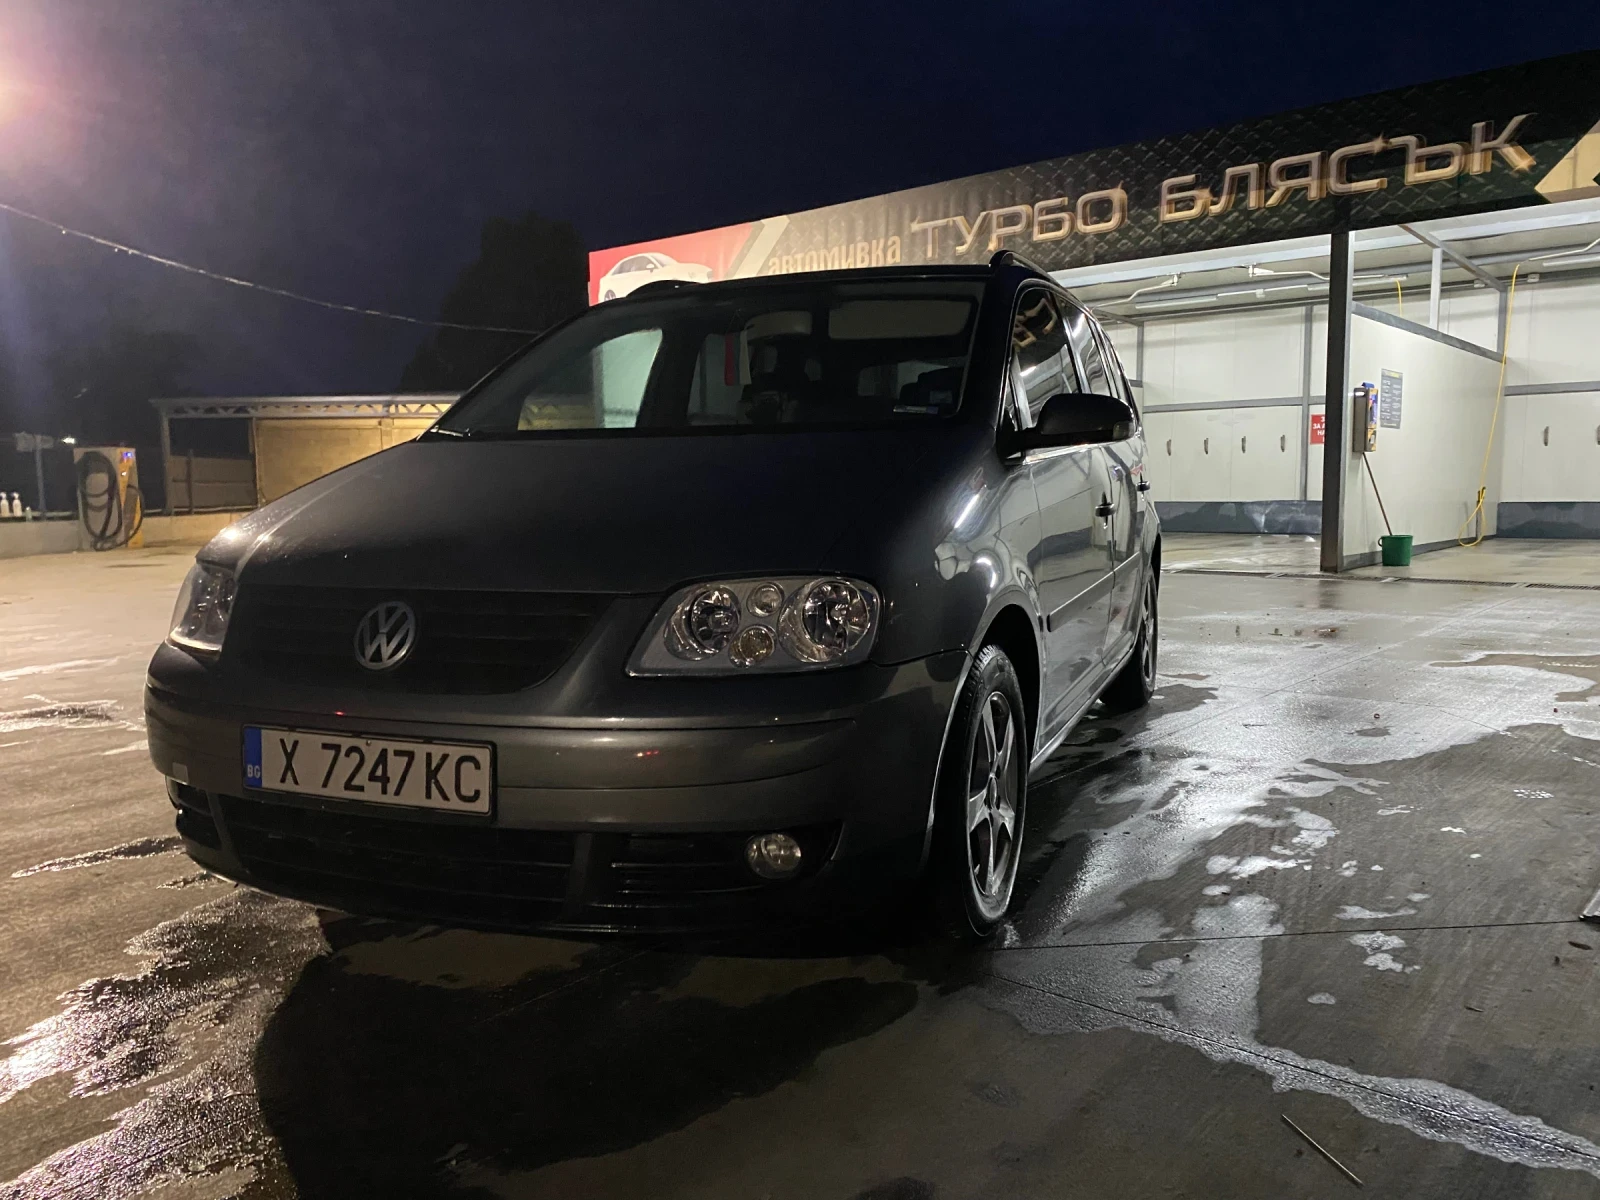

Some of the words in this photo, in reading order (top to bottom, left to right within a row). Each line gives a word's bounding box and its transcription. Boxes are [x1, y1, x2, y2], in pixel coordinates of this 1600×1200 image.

[768, 235, 901, 275] автомивка
[910, 184, 1128, 260] ТУРБО
[1159, 113, 1538, 223] БЛЯСЪК
[246, 764, 262, 779] BG
[320, 742, 416, 797] 7247
[424, 752, 482, 804] KC
